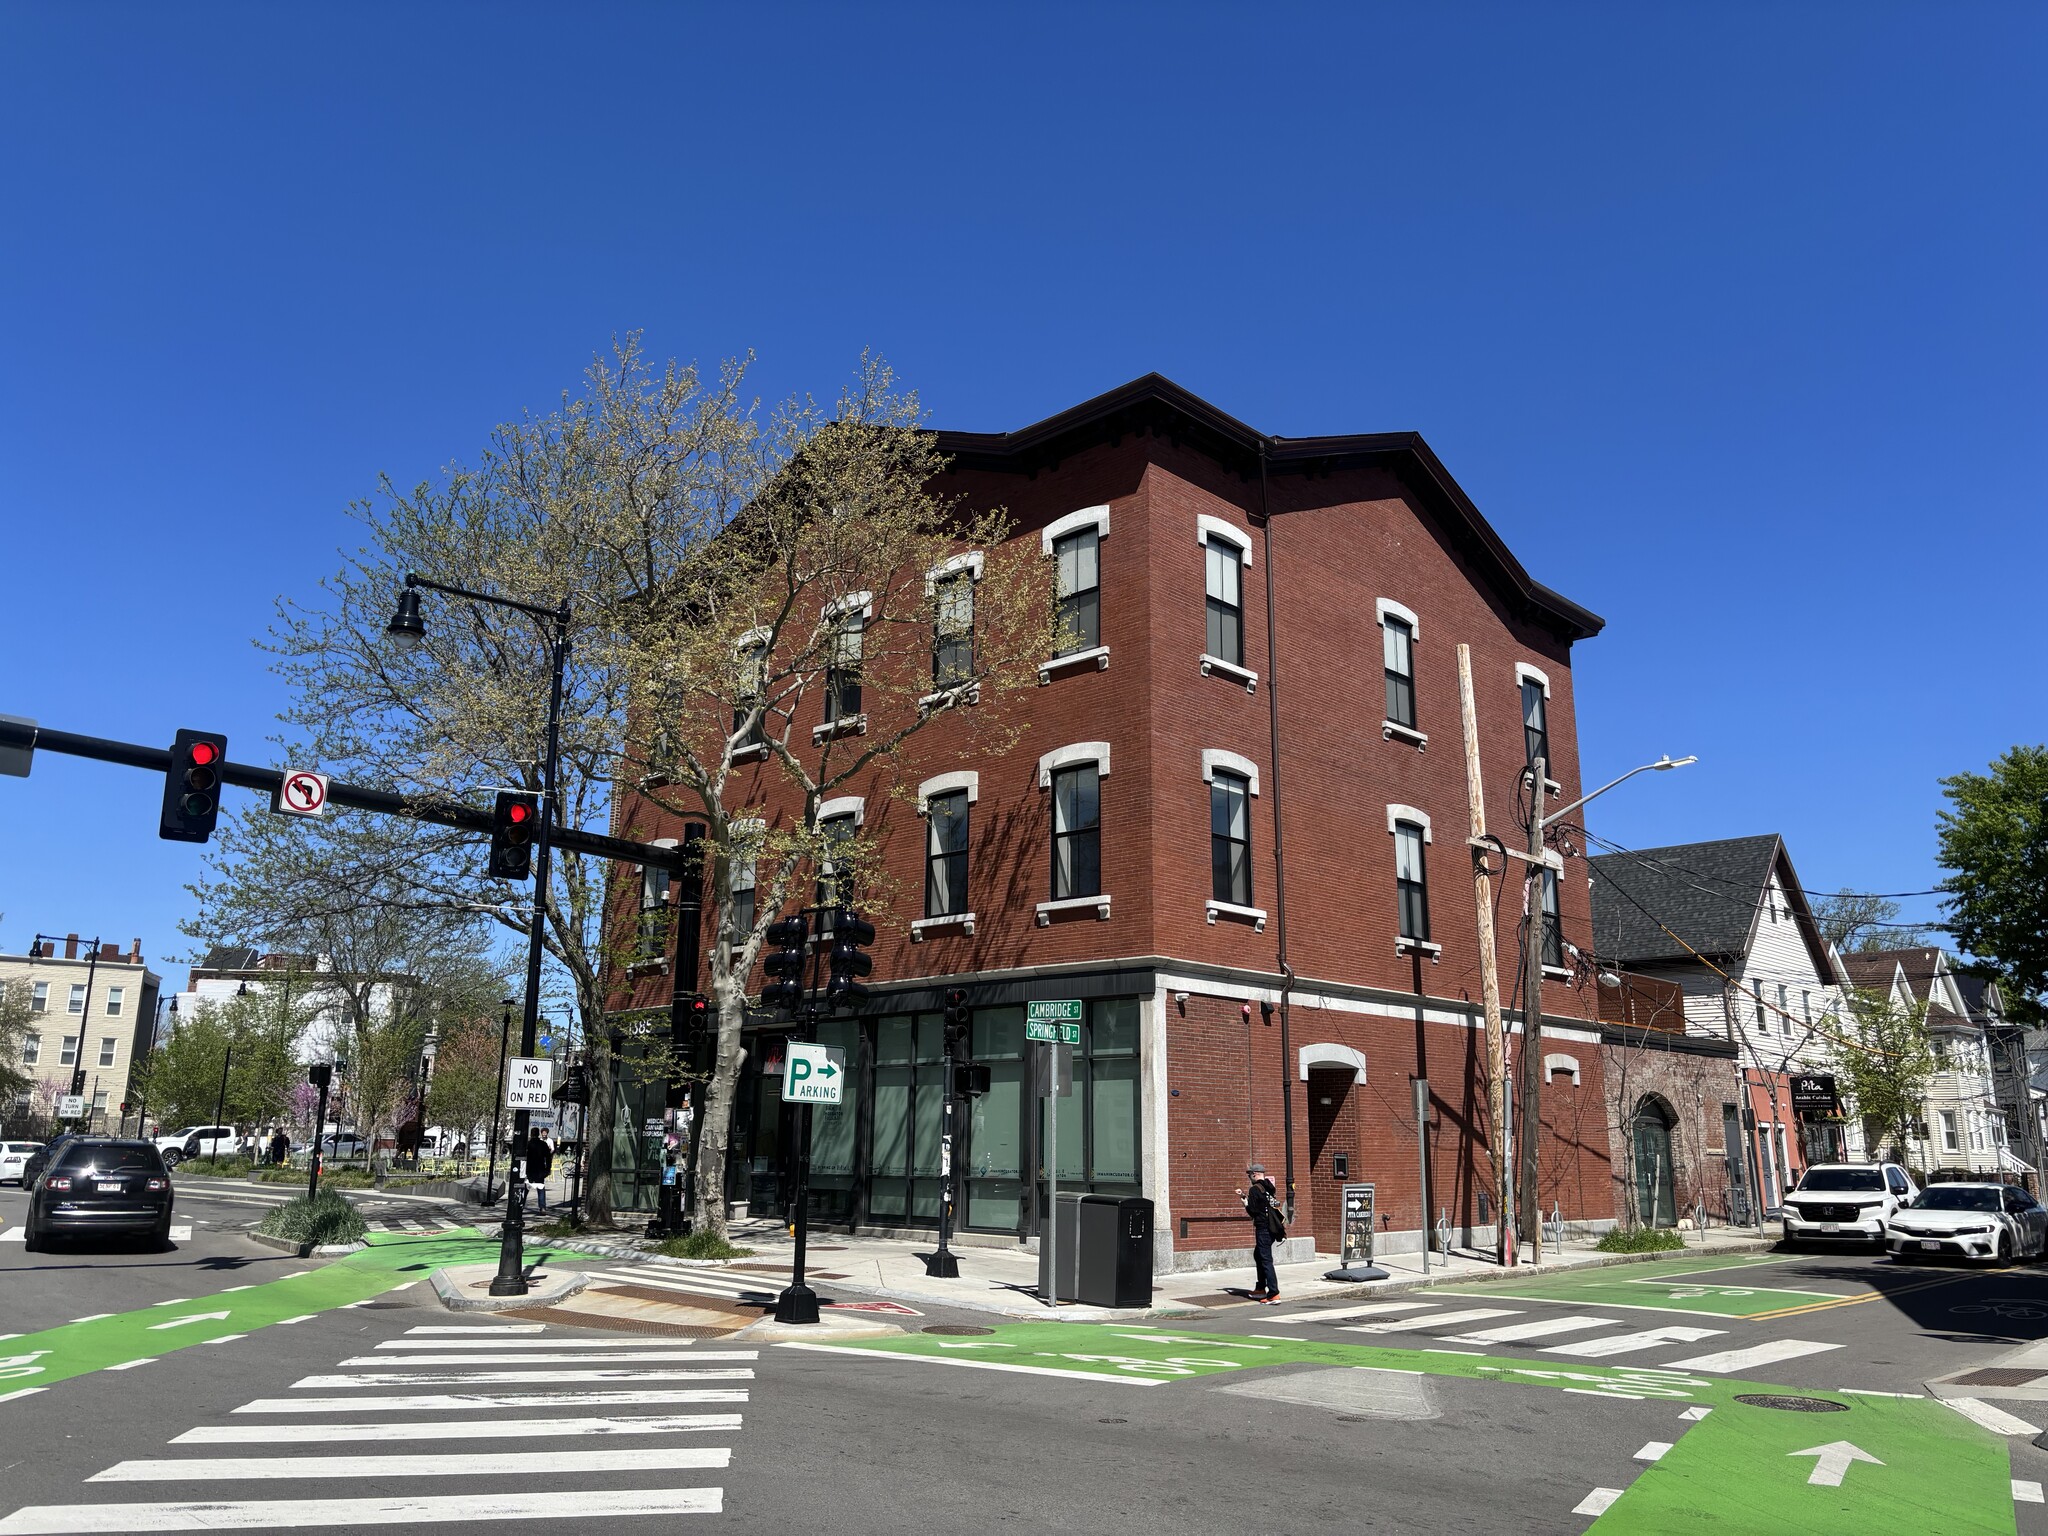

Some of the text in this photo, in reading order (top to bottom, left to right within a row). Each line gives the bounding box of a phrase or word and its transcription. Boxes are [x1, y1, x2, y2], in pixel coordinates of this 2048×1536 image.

[1030, 1003, 1079, 1017] CAMBRIDGE ST
[1029, 1023, 1077, 1040] SPRINGFIELD ST
[524, 1065, 538, 1074] NO
[518, 1078, 542, 1088] TURN
[1801, 1080, 1823, 1091] Pita
[510, 1092, 547, 1103] ON RED
